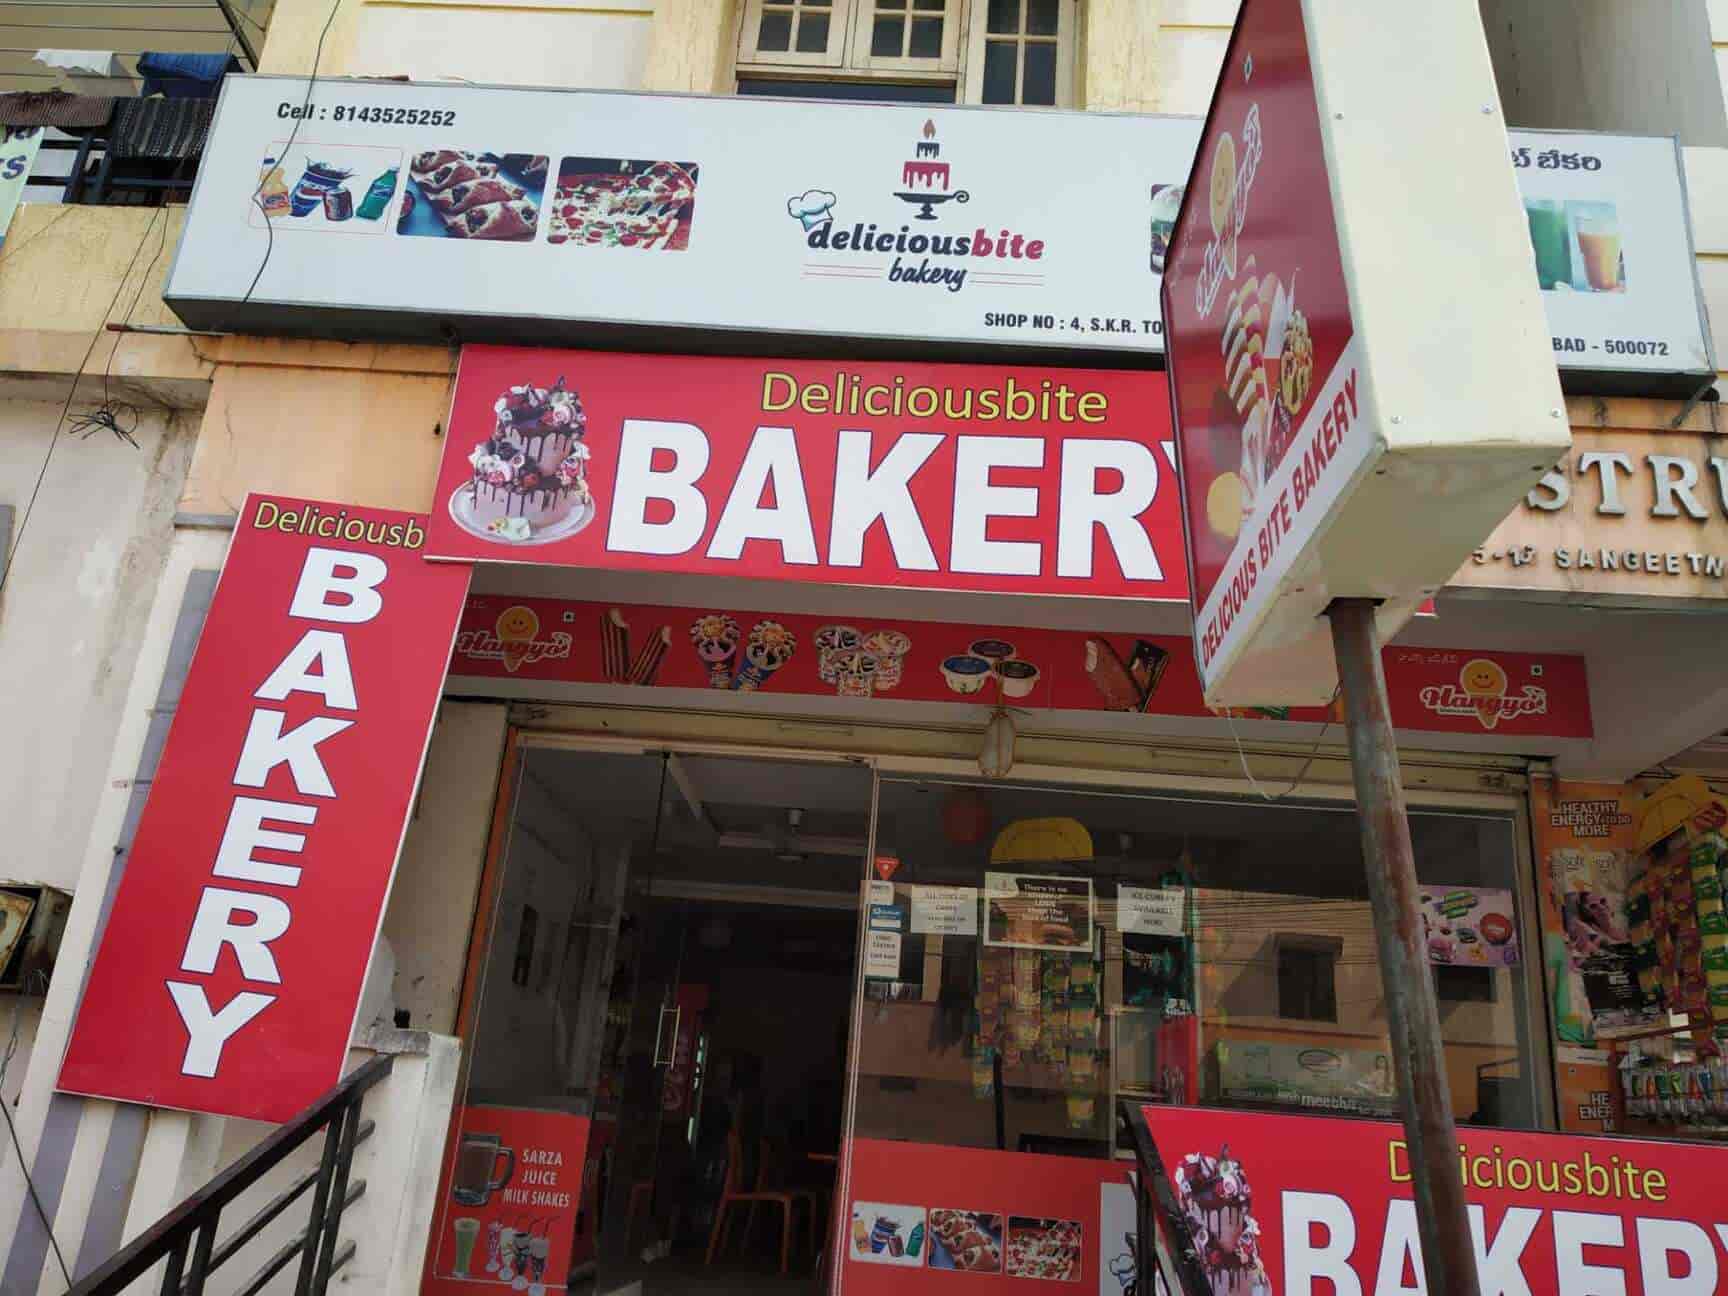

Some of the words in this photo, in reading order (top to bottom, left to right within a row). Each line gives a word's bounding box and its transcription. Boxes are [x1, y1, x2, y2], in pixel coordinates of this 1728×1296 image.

[278, 102, 314, 120] Cell
[334, 105, 456, 127] 8143525252
[888, 257, 967, 292] bakery
[984, 312, 1028, 328] SHOP
[1033, 314, 1055, 329] NO
[1090, 317, 1137, 334] S.K.R.
[1604, 340, 1669, 356] 500072
[761, 370, 1109, 424] Deliciousbite
[605, 418, 1177, 584] BAKER
[1202, 548, 1257, 669] DELICIOUS
[1257, 489, 1292, 569] BITE
[1291, 366, 1360, 514] BAKERY
[164, 546, 389, 1080] BAKERY
[1562, 801, 1617, 814] HEALTHY
[1551, 814, 1601, 826] ENERGY
[1573, 824, 1609, 836] MORE
[522, 1149, 563, 1166] SARZA
[522, 1170, 558, 1185] JUICE
[1387, 1139, 1668, 1201] Diciousbite
[503, 1188, 528, 1205] MILK
[531, 1191, 571, 1208] SHAKES
[1281, 1190, 1728, 1296] BAKER
